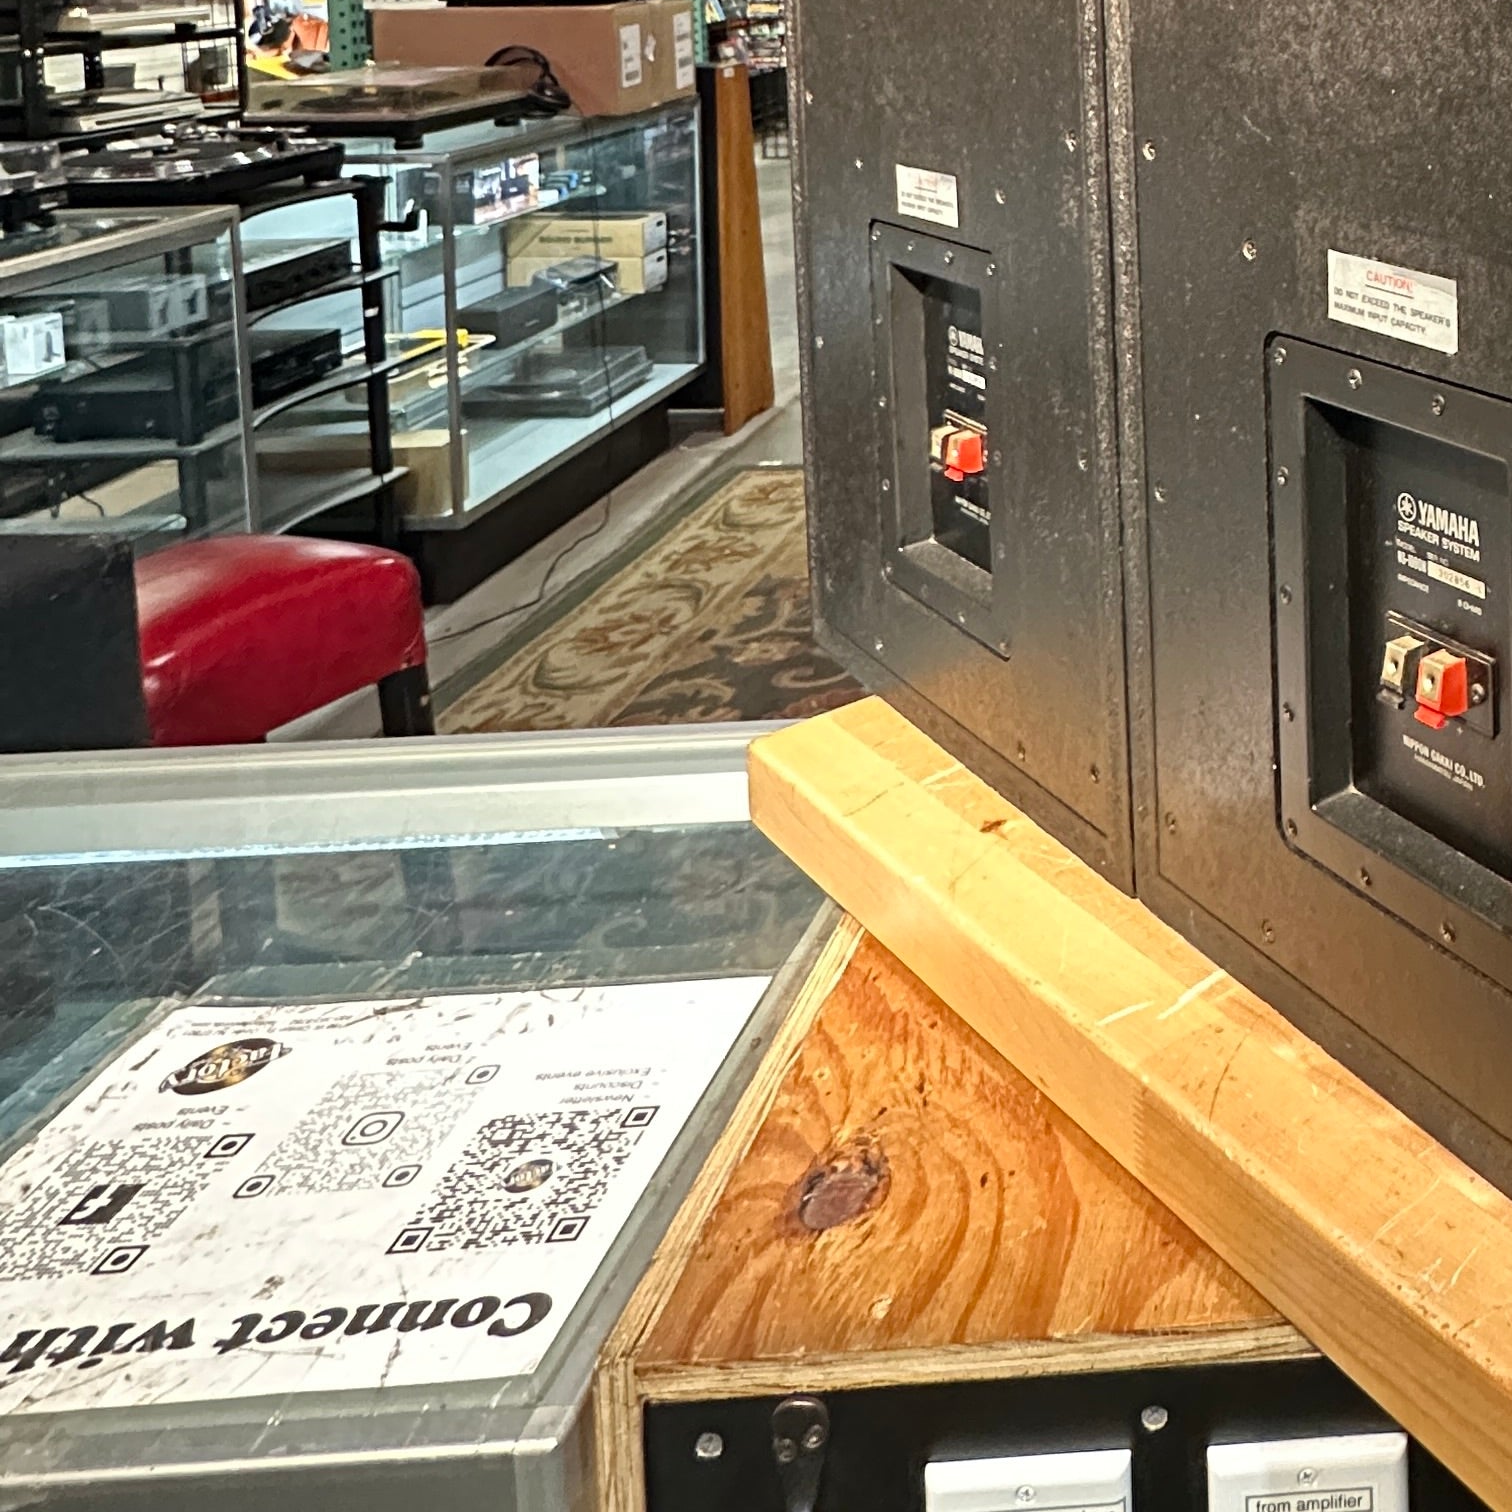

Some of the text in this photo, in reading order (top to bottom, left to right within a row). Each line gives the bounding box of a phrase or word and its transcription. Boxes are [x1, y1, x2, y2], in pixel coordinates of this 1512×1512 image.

[1333, 287, 1344, 296] DO
[1346, 290, 1359, 300] NOT
[1361, 294, 1390, 310] EXCEED
[1393, 303, 1407, 315] THE
[1334, 301, 1365, 317] MAXIMUM
[1368, 311, 1388, 323] INPUT
[1418, 499, 1480, 547] YAMAHA
[1397, 520, 1481, 562] SPEAKER SYSTEM
[1403, 734, 1430, 758] NIPPON
[1430, 749, 1453, 771] GAKKI
[425, 1042, 472, 1051] Events
[386, 1054, 463, 1066] Daily posts
[535, 1067, 652, 1081] Exclusive events
[574, 1080, 643, 1091] Discounts
[559, 1094, 635, 1104] Newsletter
[176, 1105, 229, 1115] Events
[132, 1119, 215, 1131] Daily posts
[0, 1291, 553, 1374] Connect with
[1256, 1495, 1363, 1512] from amplifier
